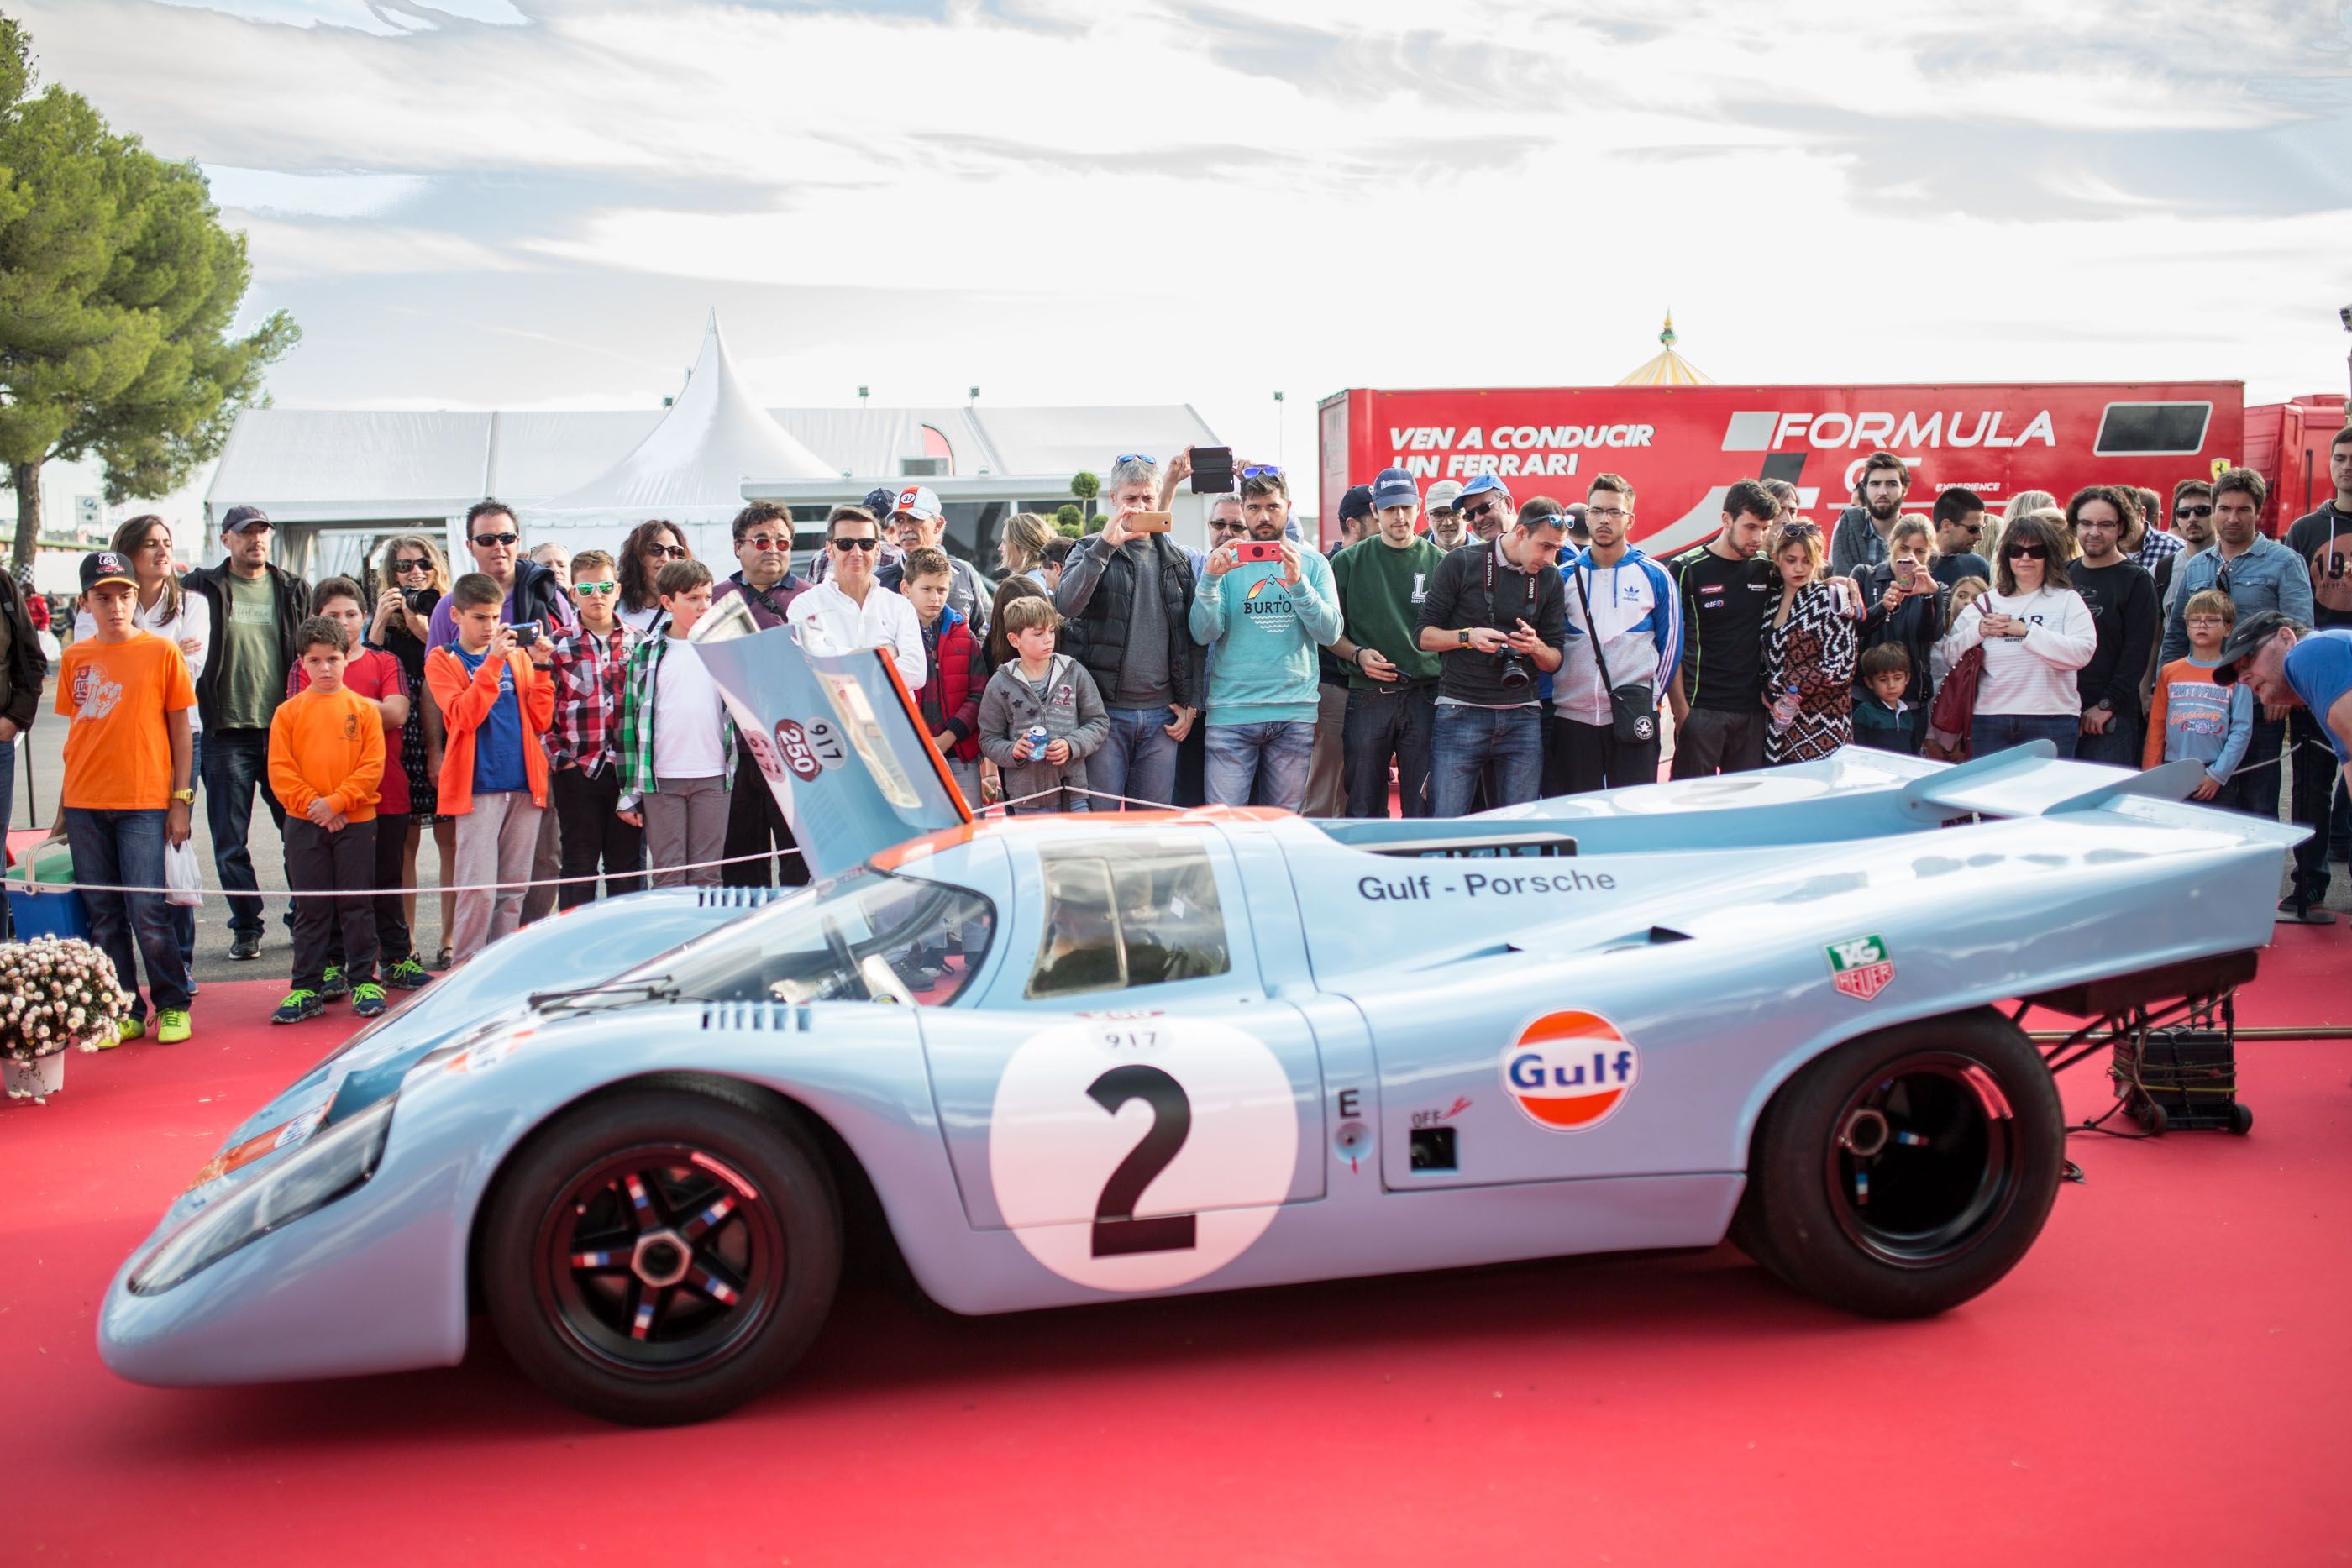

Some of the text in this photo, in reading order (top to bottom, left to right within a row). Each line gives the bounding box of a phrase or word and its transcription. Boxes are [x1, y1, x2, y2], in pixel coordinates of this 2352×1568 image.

[1390, 424, 1656, 450] VEN A CONDUCIR
[1772, 410, 2057, 449] FORMULA
[1392, 453, 1579, 478] UN FERRARI
[2314, 551, 2352, 580] 19
[1411, 572, 1428, 599] L
[1243, 600, 1296, 615] BURTO
[779, 728, 816, 774] 250
[810, 724, 843, 759] 917
[1357, 876, 1431, 901] Gulf
[1463, 869, 1615, 897] Porsche
[1834, 939, 1881, 968] TAG
[1840, 965, 1892, 994] HEUER
[1105, 1031, 1156, 1048] 917
[1509, 1050, 1633, 1089] Gulf
[1339, 1089, 1362, 1120] E
[1411, 1109, 1441, 1128] OFF
[1085, 1064, 1198, 1261] 2
